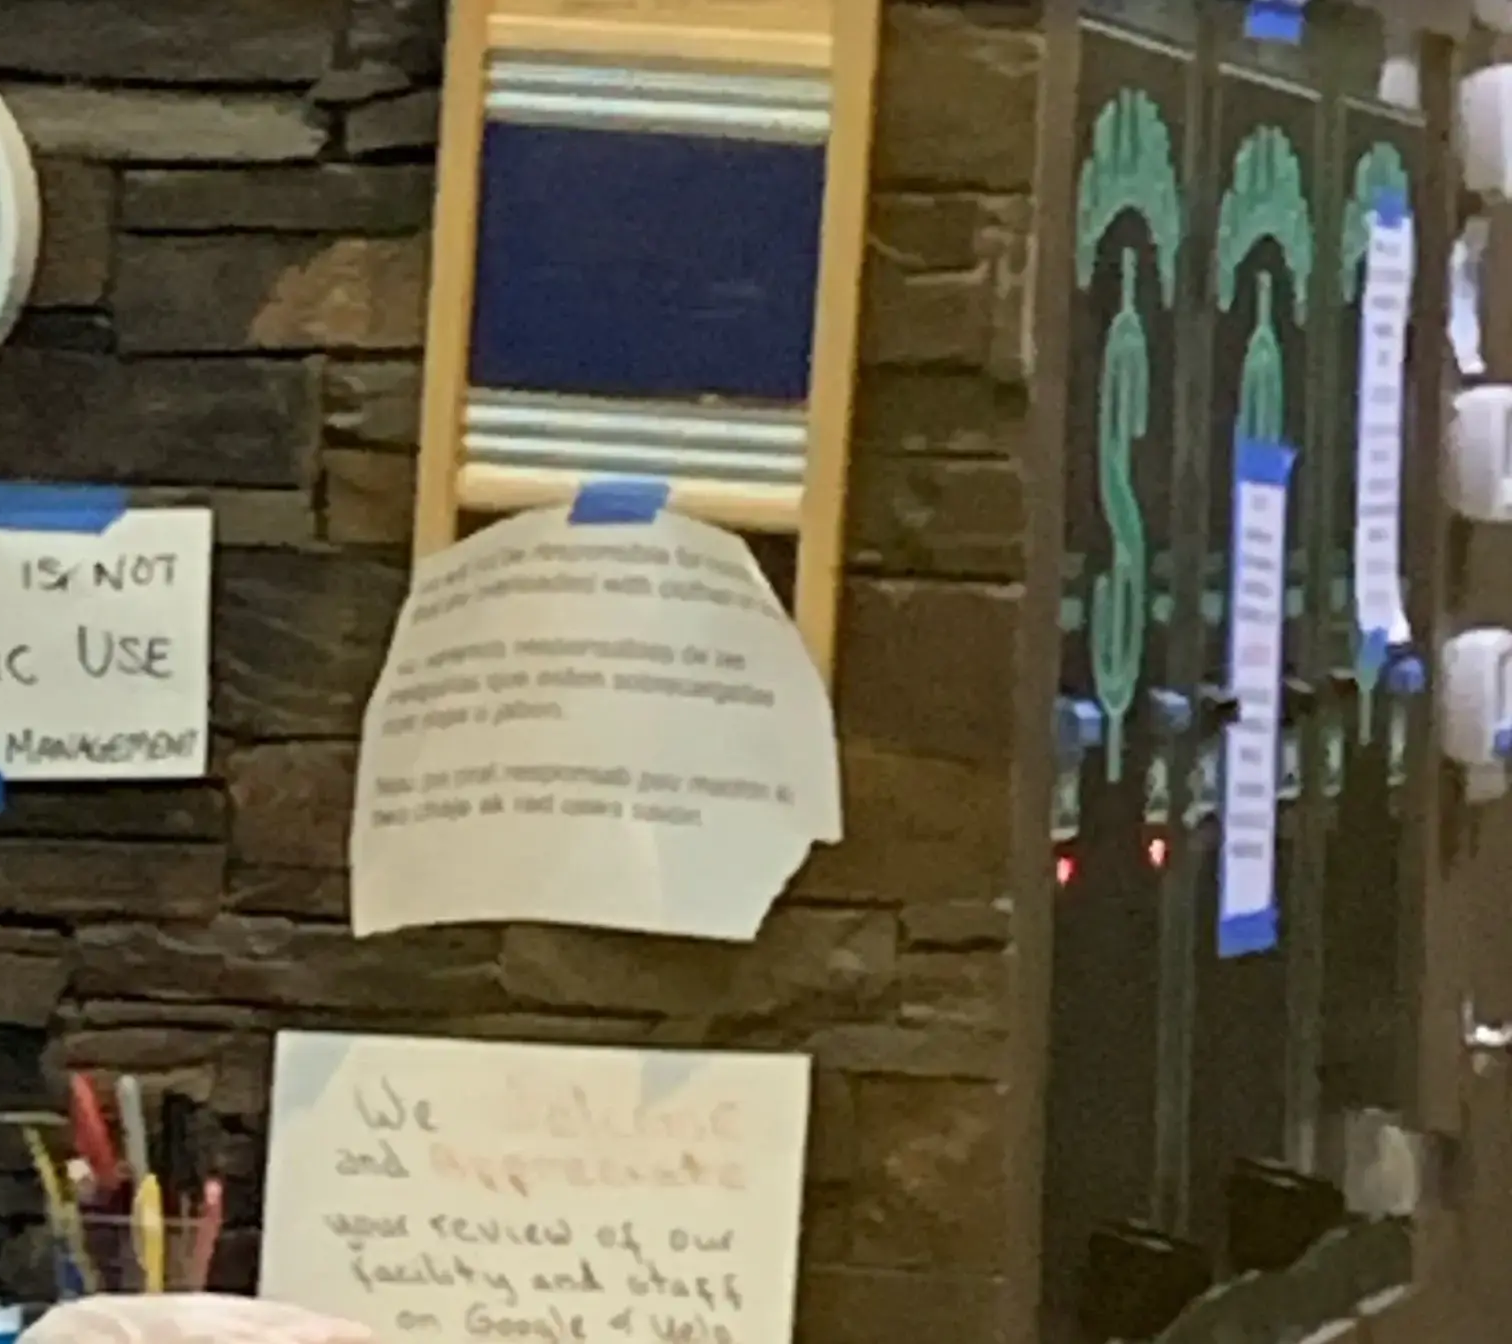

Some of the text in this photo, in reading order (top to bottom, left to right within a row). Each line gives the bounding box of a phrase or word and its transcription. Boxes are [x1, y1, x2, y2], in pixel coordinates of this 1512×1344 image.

[92, 553, 178, 591] NOT
[76, 624, 174, 679] USE
[352, 1074, 440, 1132] We
[334, 1138, 411, 1179] and
[428, 1212, 573, 1246] review
[594, 1220, 643, 1264] of
[668, 1225, 735, 1252] our
[531, 1257, 605, 1293] and
[626, 1258, 744, 1312] staff
[394, 1308, 444, 1334] on
